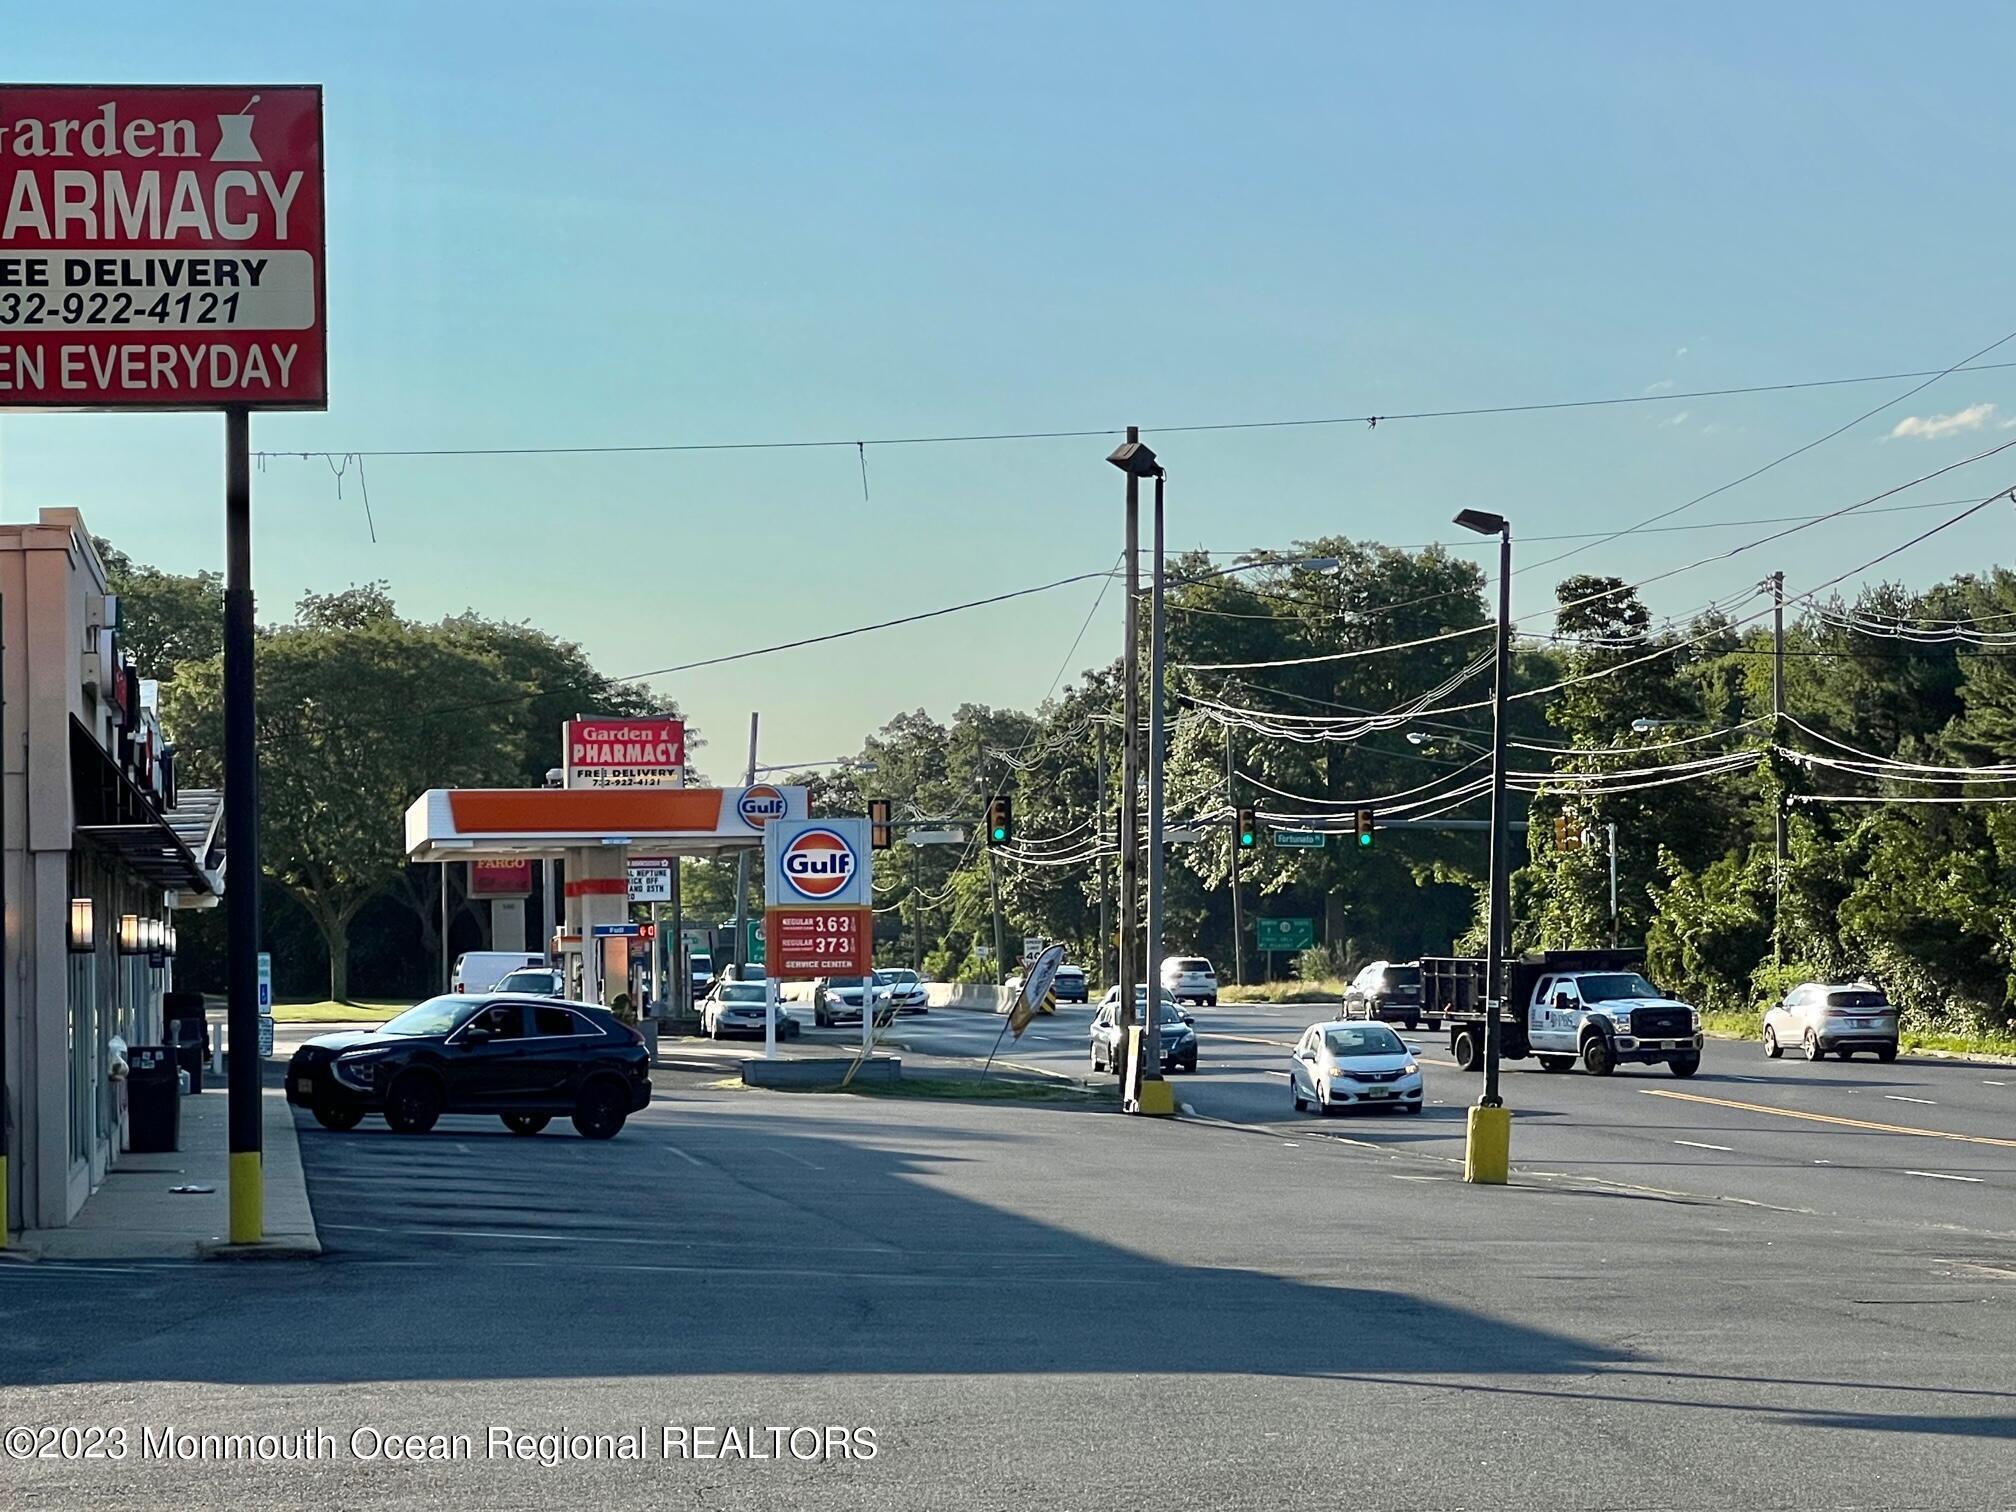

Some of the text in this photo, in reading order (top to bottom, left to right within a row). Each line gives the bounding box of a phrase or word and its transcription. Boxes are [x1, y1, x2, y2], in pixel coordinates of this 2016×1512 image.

[0, 101, 201, 157] arden
[2, 170, 304, 240] ARMACY
[0, 258, 268, 287] EE DELIVERY
[0, 292, 240, 324] 32-922-4121
[61, 343, 298, 390] EVERYDAY
[583, 727, 652, 741] Garden
[573, 743, 679, 763] PHARMACY
[612, 768, 675, 777] DELIVERY
[741, 799, 783, 814] Gulf
[477, 858, 526, 869] FARGO
[786, 853, 850, 874] Gulf
[637, 869, 667, 877] NEPTUNE
[646, 877, 659, 885] OFF
[816, 916, 849, 932] 3.63
[785, 960, 853, 968] SERVICE CENTER
